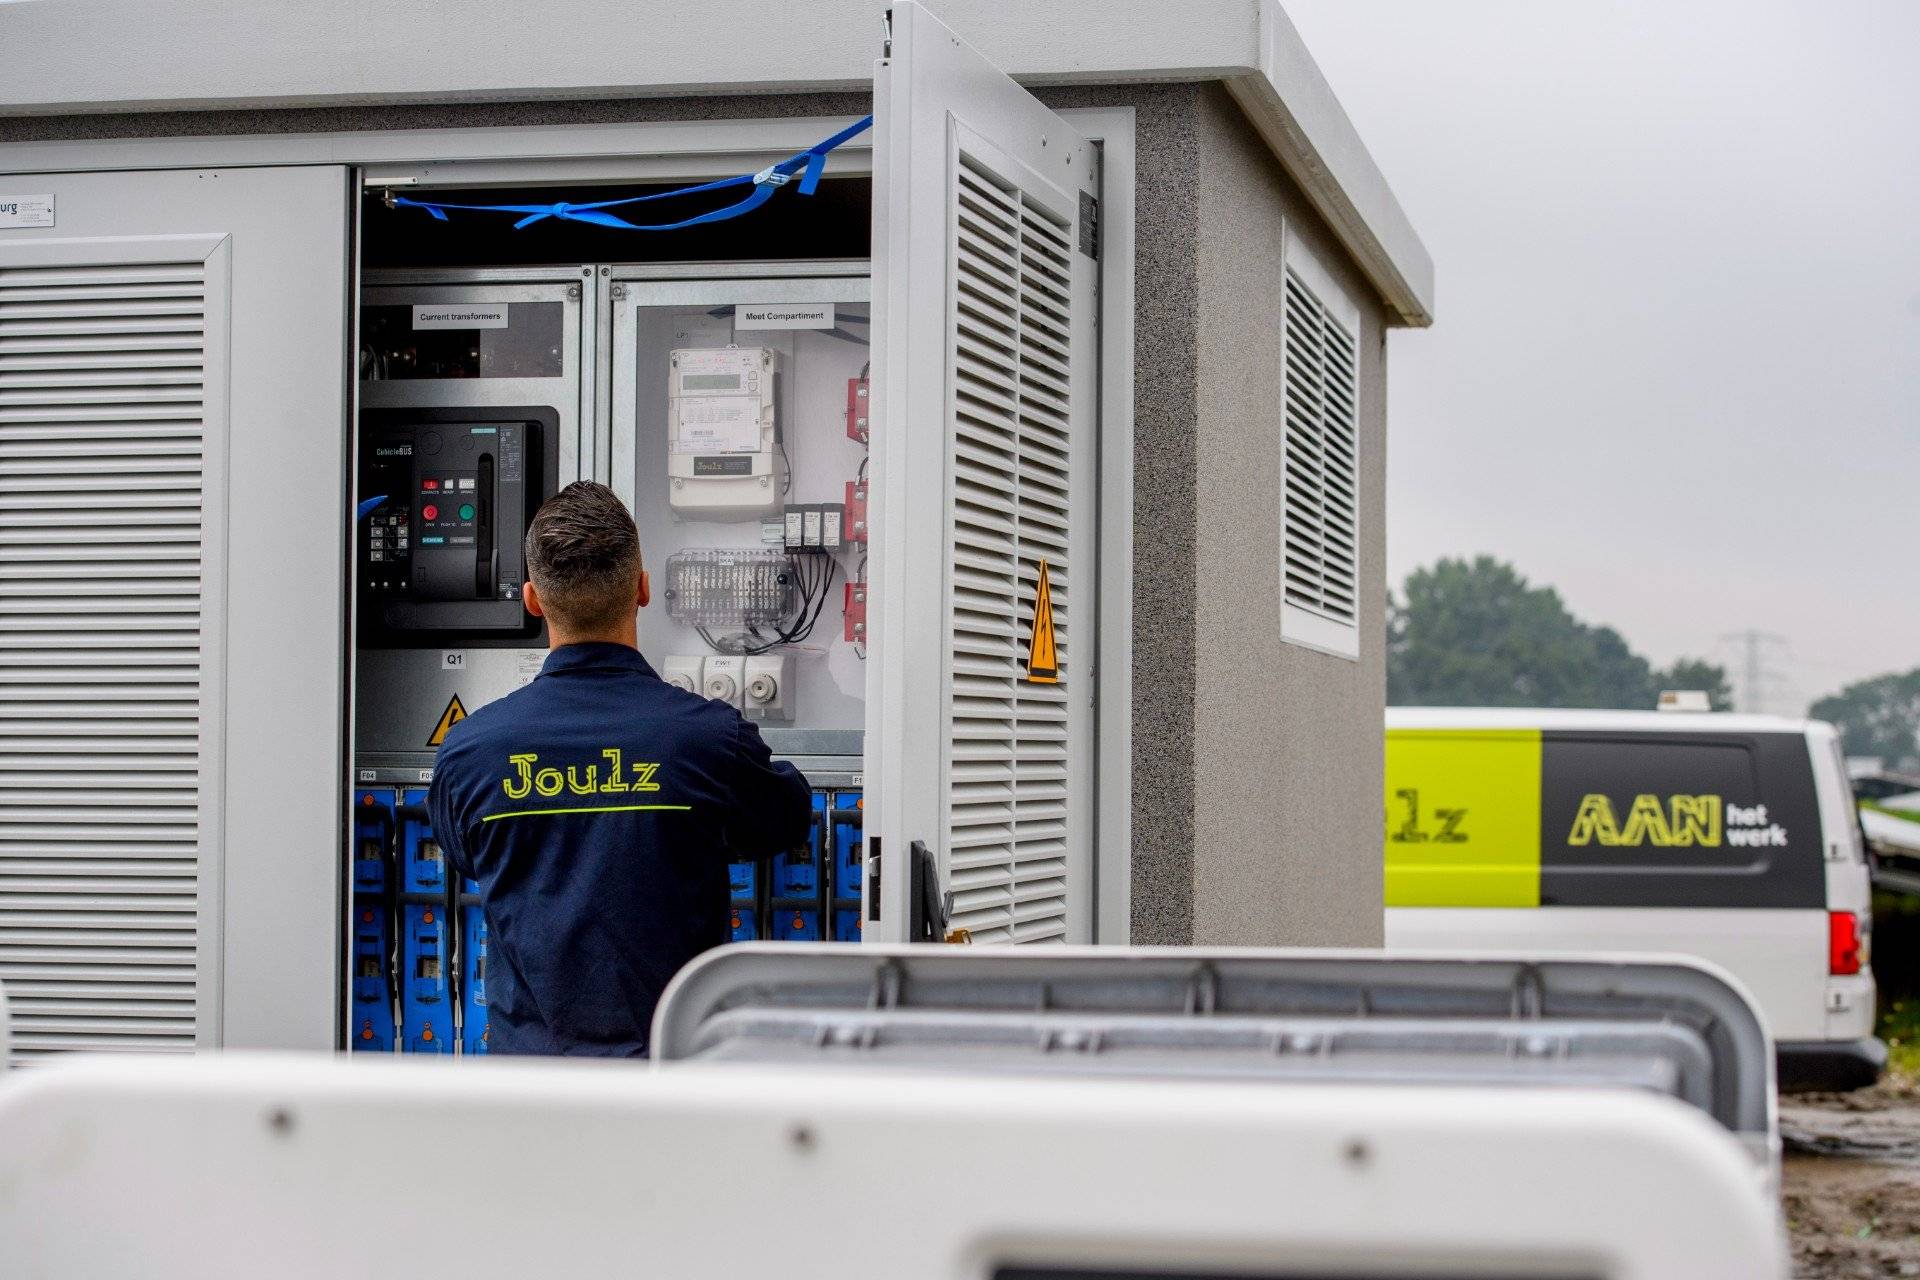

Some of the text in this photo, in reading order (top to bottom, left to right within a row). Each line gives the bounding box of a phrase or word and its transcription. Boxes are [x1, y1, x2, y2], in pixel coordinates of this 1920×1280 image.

[0, 203, 18, 215] urg
[420, 312, 501, 321] Current transformers
[766, 312, 824, 321] Compartiment
[447, 654, 463, 665] Q1
[503, 748, 661, 799] Joulz
[1384, 787, 1469, 844] lz
[1567, 793, 1768, 848] AAN het
[1726, 823, 1789, 848] werk
